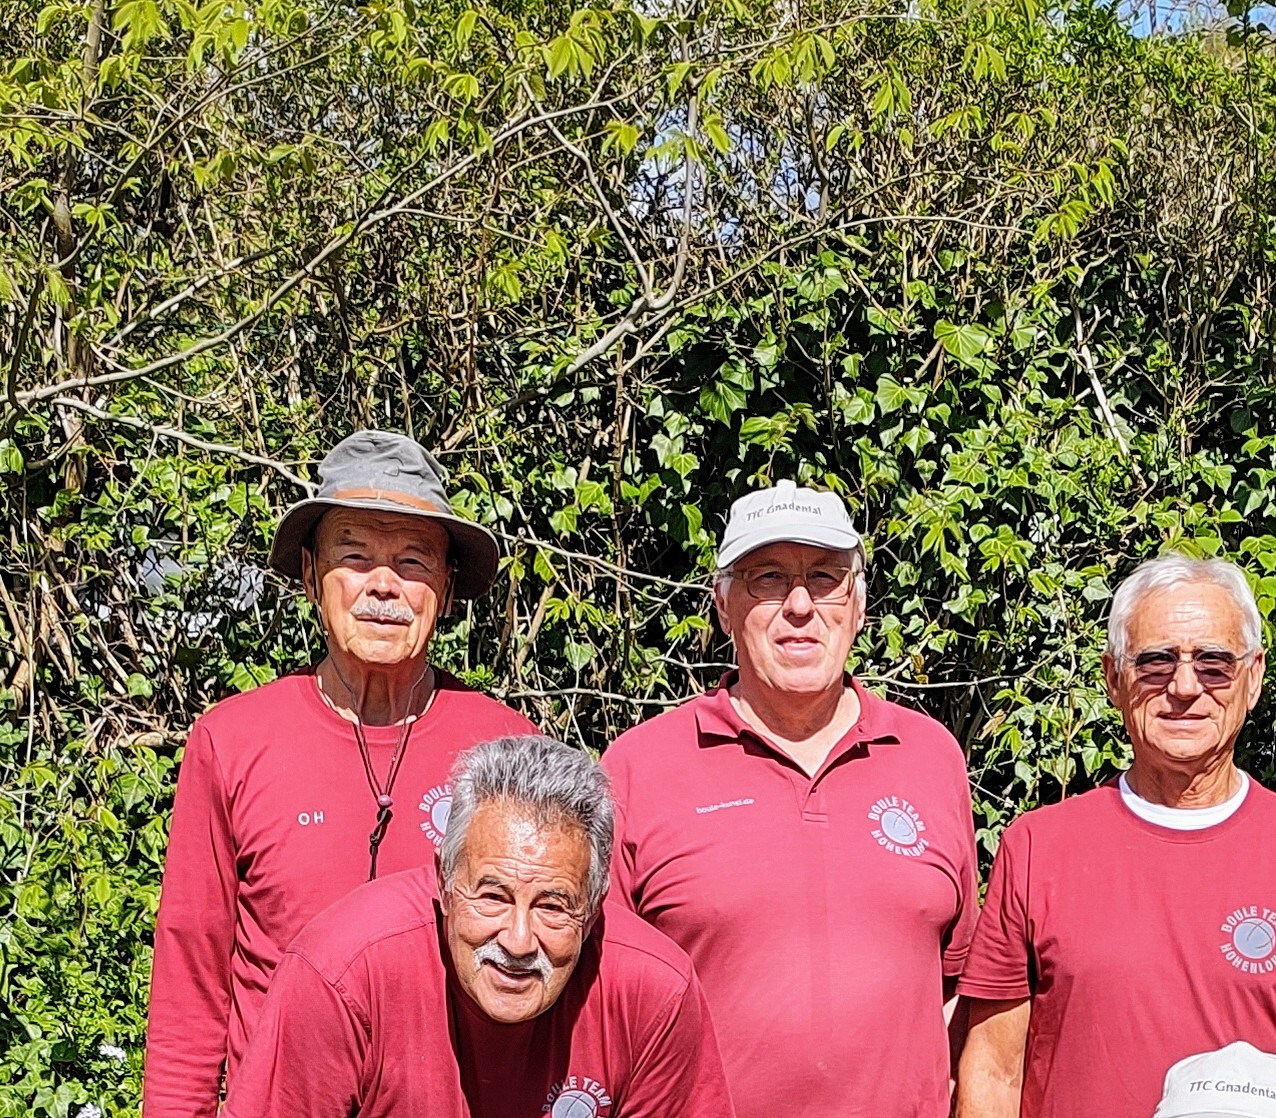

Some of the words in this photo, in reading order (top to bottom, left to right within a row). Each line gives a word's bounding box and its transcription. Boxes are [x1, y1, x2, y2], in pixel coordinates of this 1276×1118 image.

[418, 784, 453, 813] BOULE
[867, 795, 900, 821] BOULE
[901, 799, 927, 832] TEAM
[1220, 906, 1258, 933] BOULE
[582, 1076, 612, 1107] TEAM
[1189, 1080, 1213, 1093] TTC
